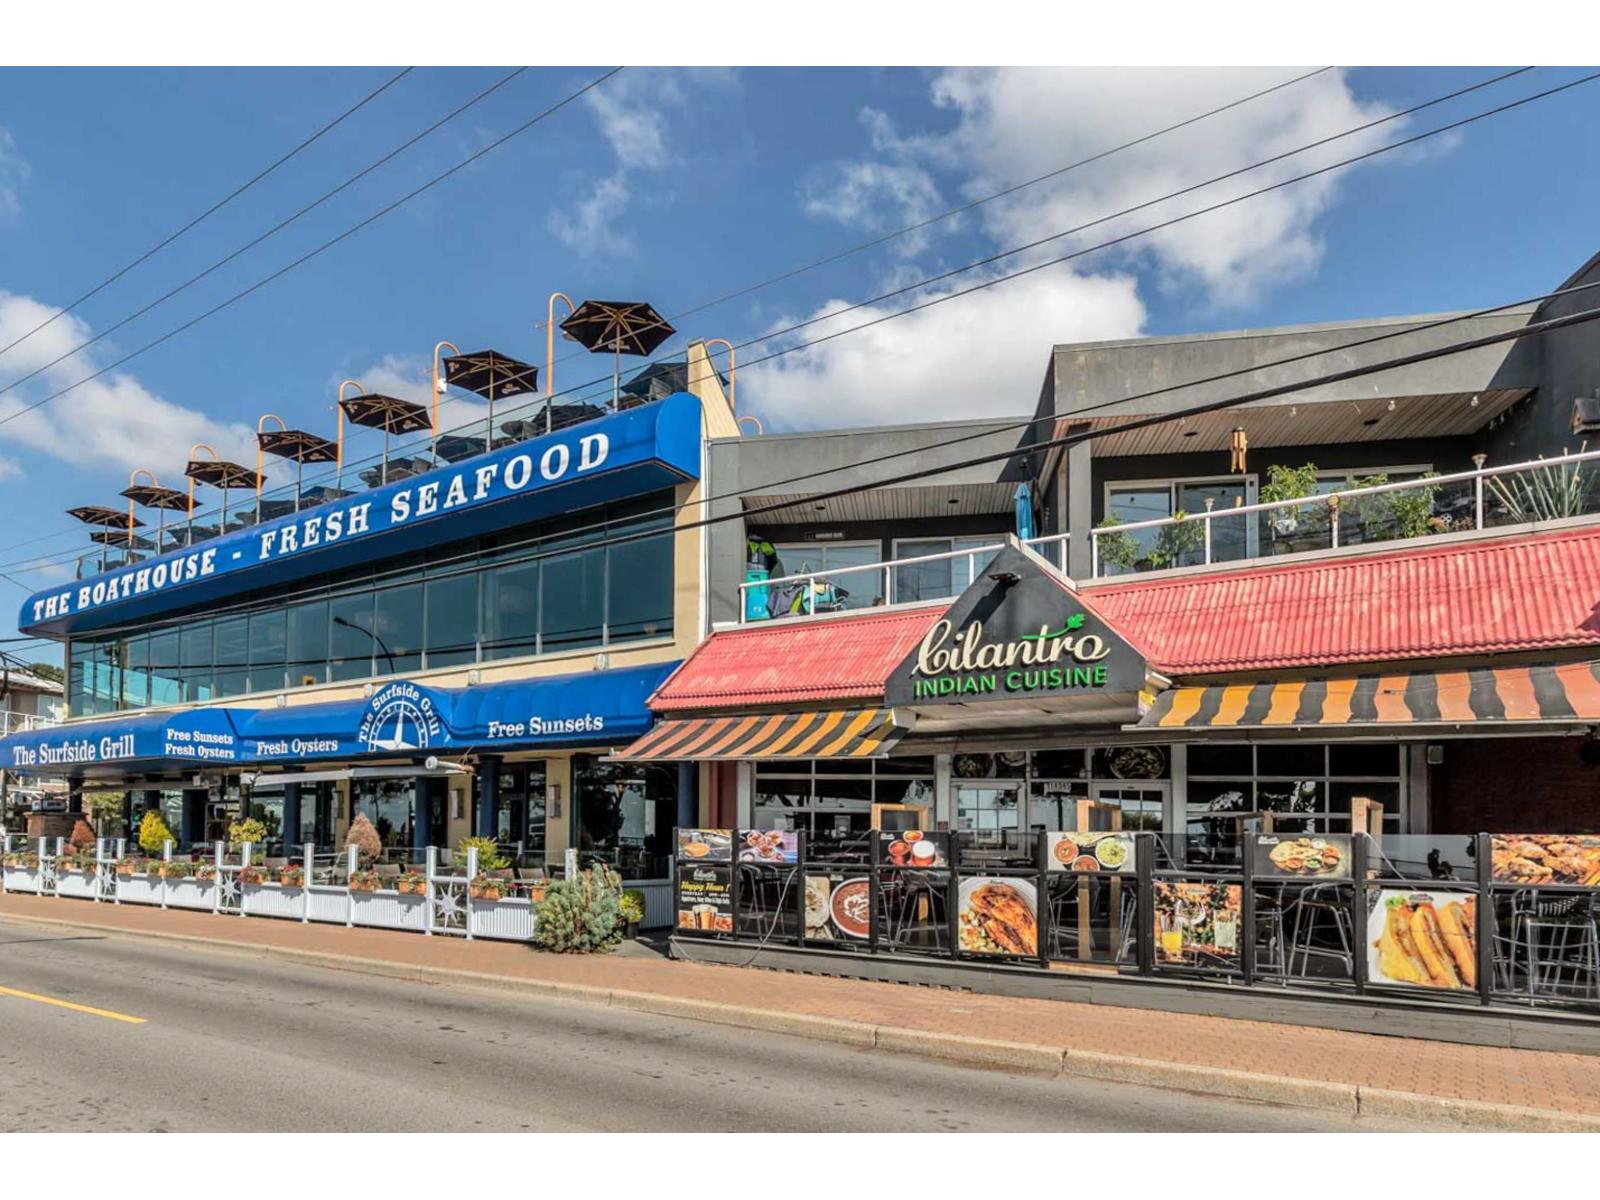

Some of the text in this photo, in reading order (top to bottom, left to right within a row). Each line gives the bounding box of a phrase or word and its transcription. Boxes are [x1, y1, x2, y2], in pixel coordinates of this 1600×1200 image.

[33, 593, 70, 621] THE
[77, 548, 217, 610] BOATHOUSE
[259, 502, 372, 560] FRESH
[391, 432, 610, 522] SEAFOOD
[911, 617, 1111, 677] Cilantro
[914, 666, 1109, 697] INDIAN CUISINE
[358, 683, 440, 743] The Surfside Grill
[487, 713, 604, 739] Free Sunsets
[13, 734, 135, 766] The Surfside Grill
[165, 743, 235, 759] Fresh Oysters
[167, 728, 234, 745] Free Sunsets
[256, 738, 338, 757] Fresh Oysters
